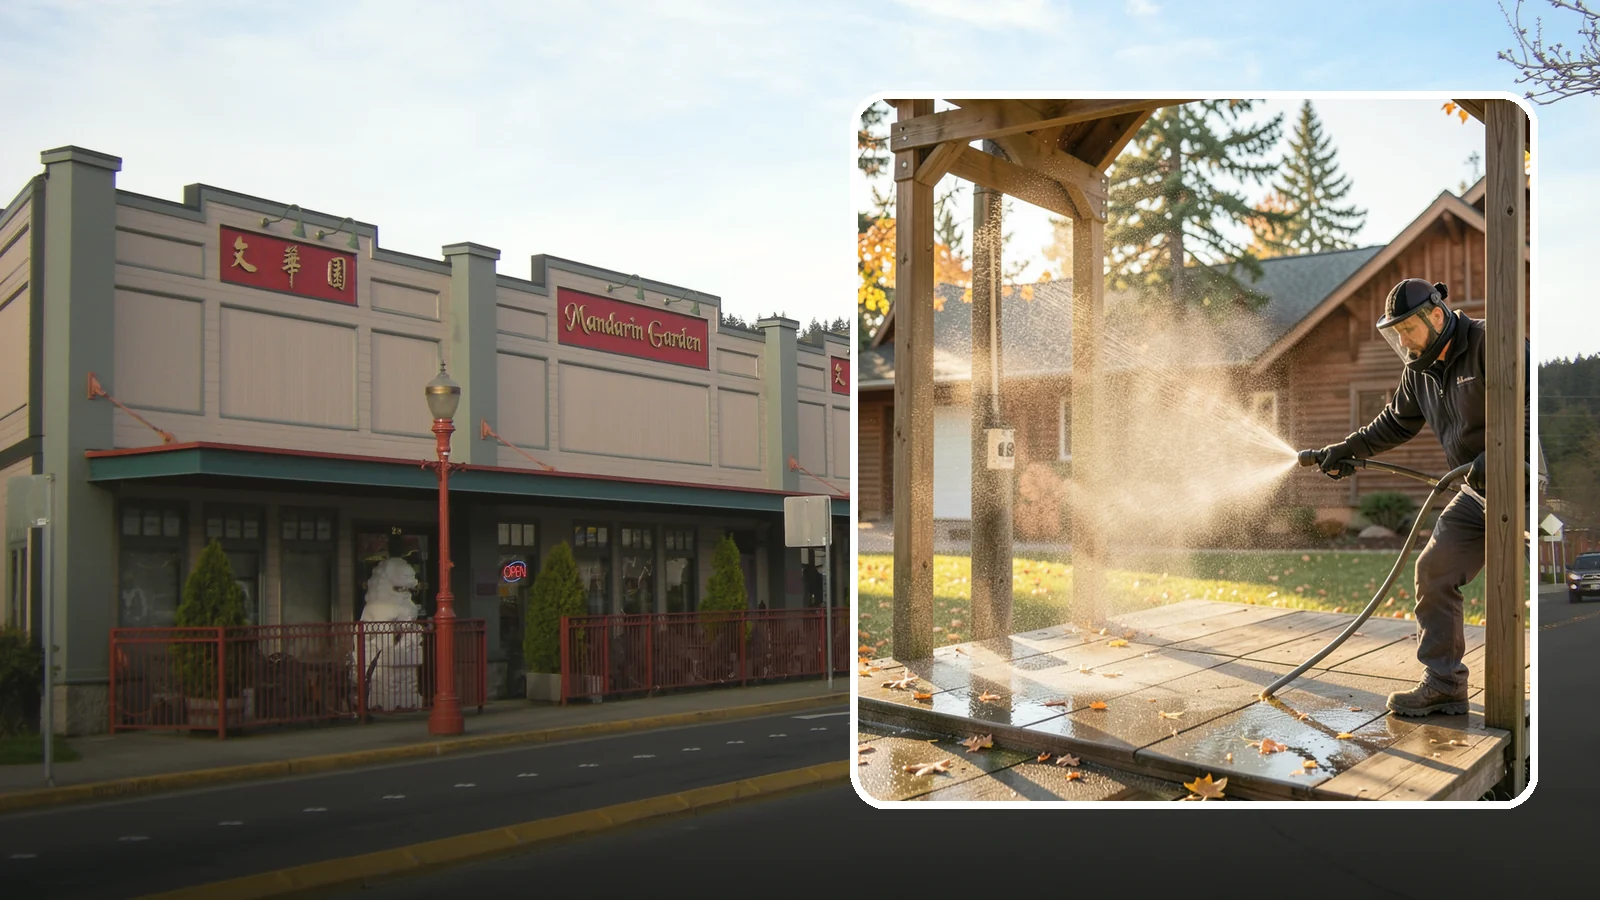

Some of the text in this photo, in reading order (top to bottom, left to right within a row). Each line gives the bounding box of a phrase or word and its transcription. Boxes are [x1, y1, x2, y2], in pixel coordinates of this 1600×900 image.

[231, 235, 347, 291] 文華園
[564, 302, 701, 352] Mandarin Garden
[503, 565, 527, 578] OPEN
